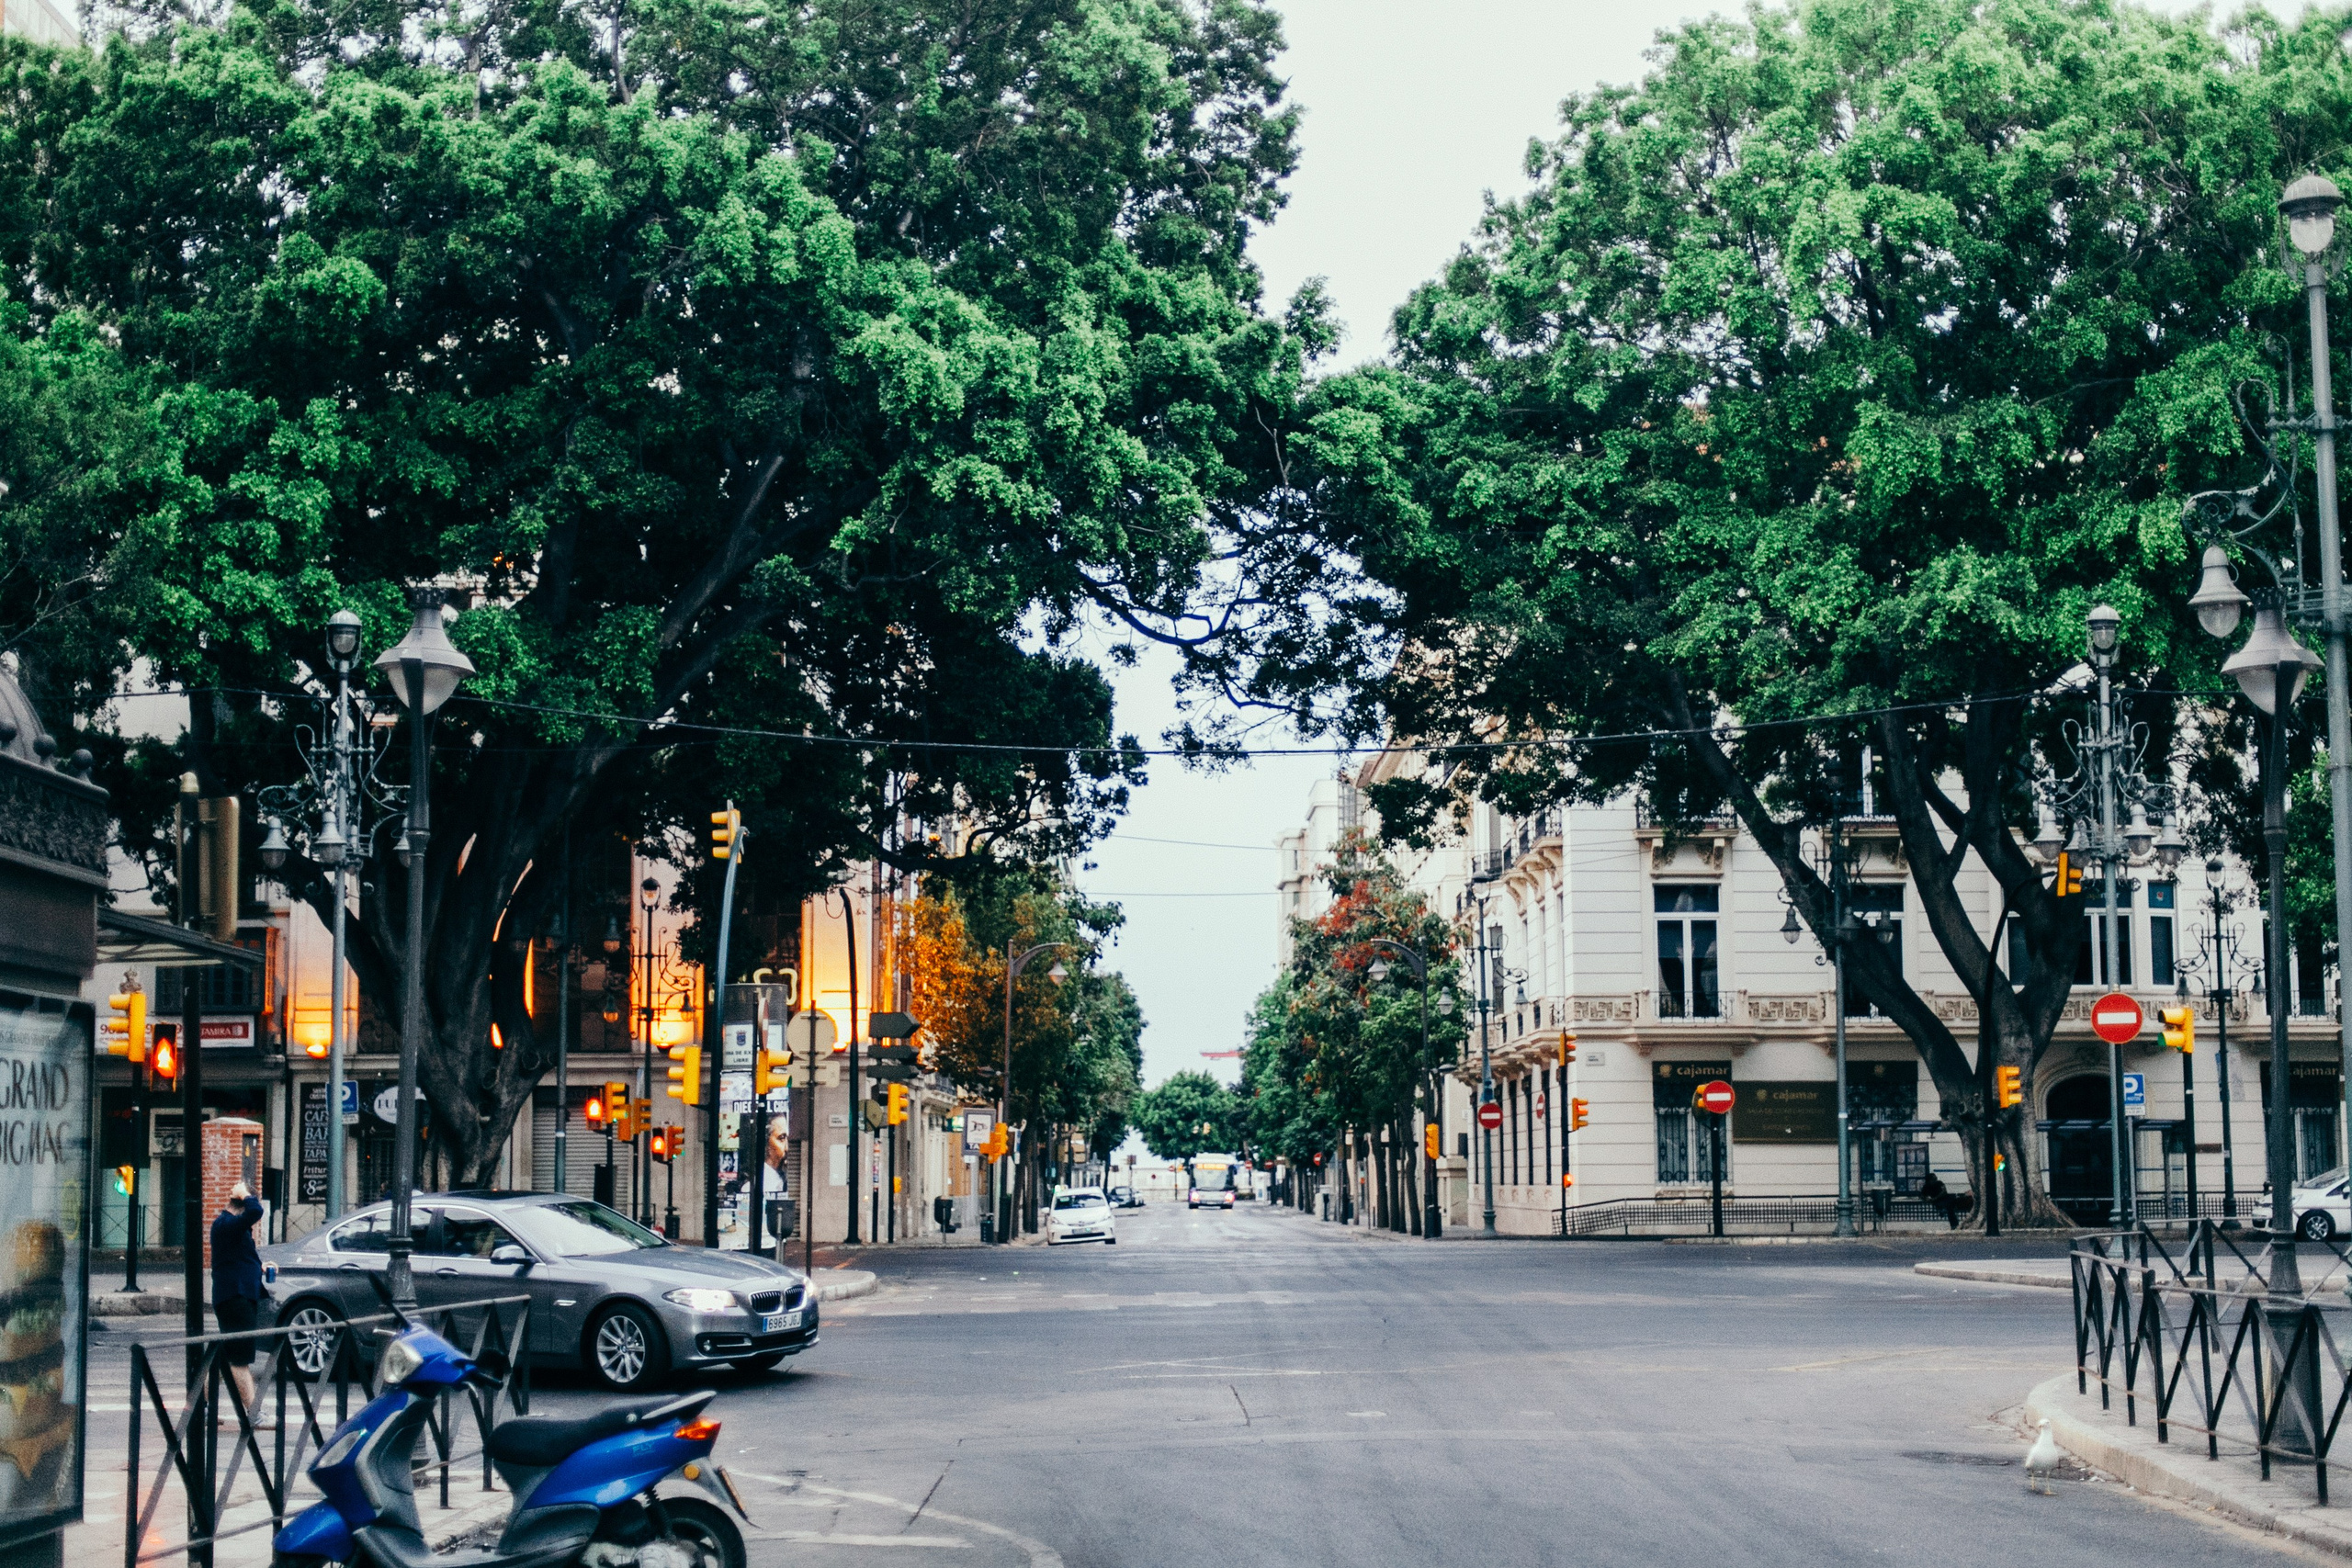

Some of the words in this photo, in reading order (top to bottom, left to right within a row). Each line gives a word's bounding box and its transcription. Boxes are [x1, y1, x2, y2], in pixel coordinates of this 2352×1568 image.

[1677, 1064, 1729, 1077] cajamar
[2291, 1066, 2337, 1078] ajamar
[1772, 1089, 1818, 1101] cajamar
[2123, 1077, 2138, 1101] P
[304, 1149, 327, 1157] TAPA
[303, 1166, 327, 1174] Fritur
[768, 1316, 787, 1329] 6965
